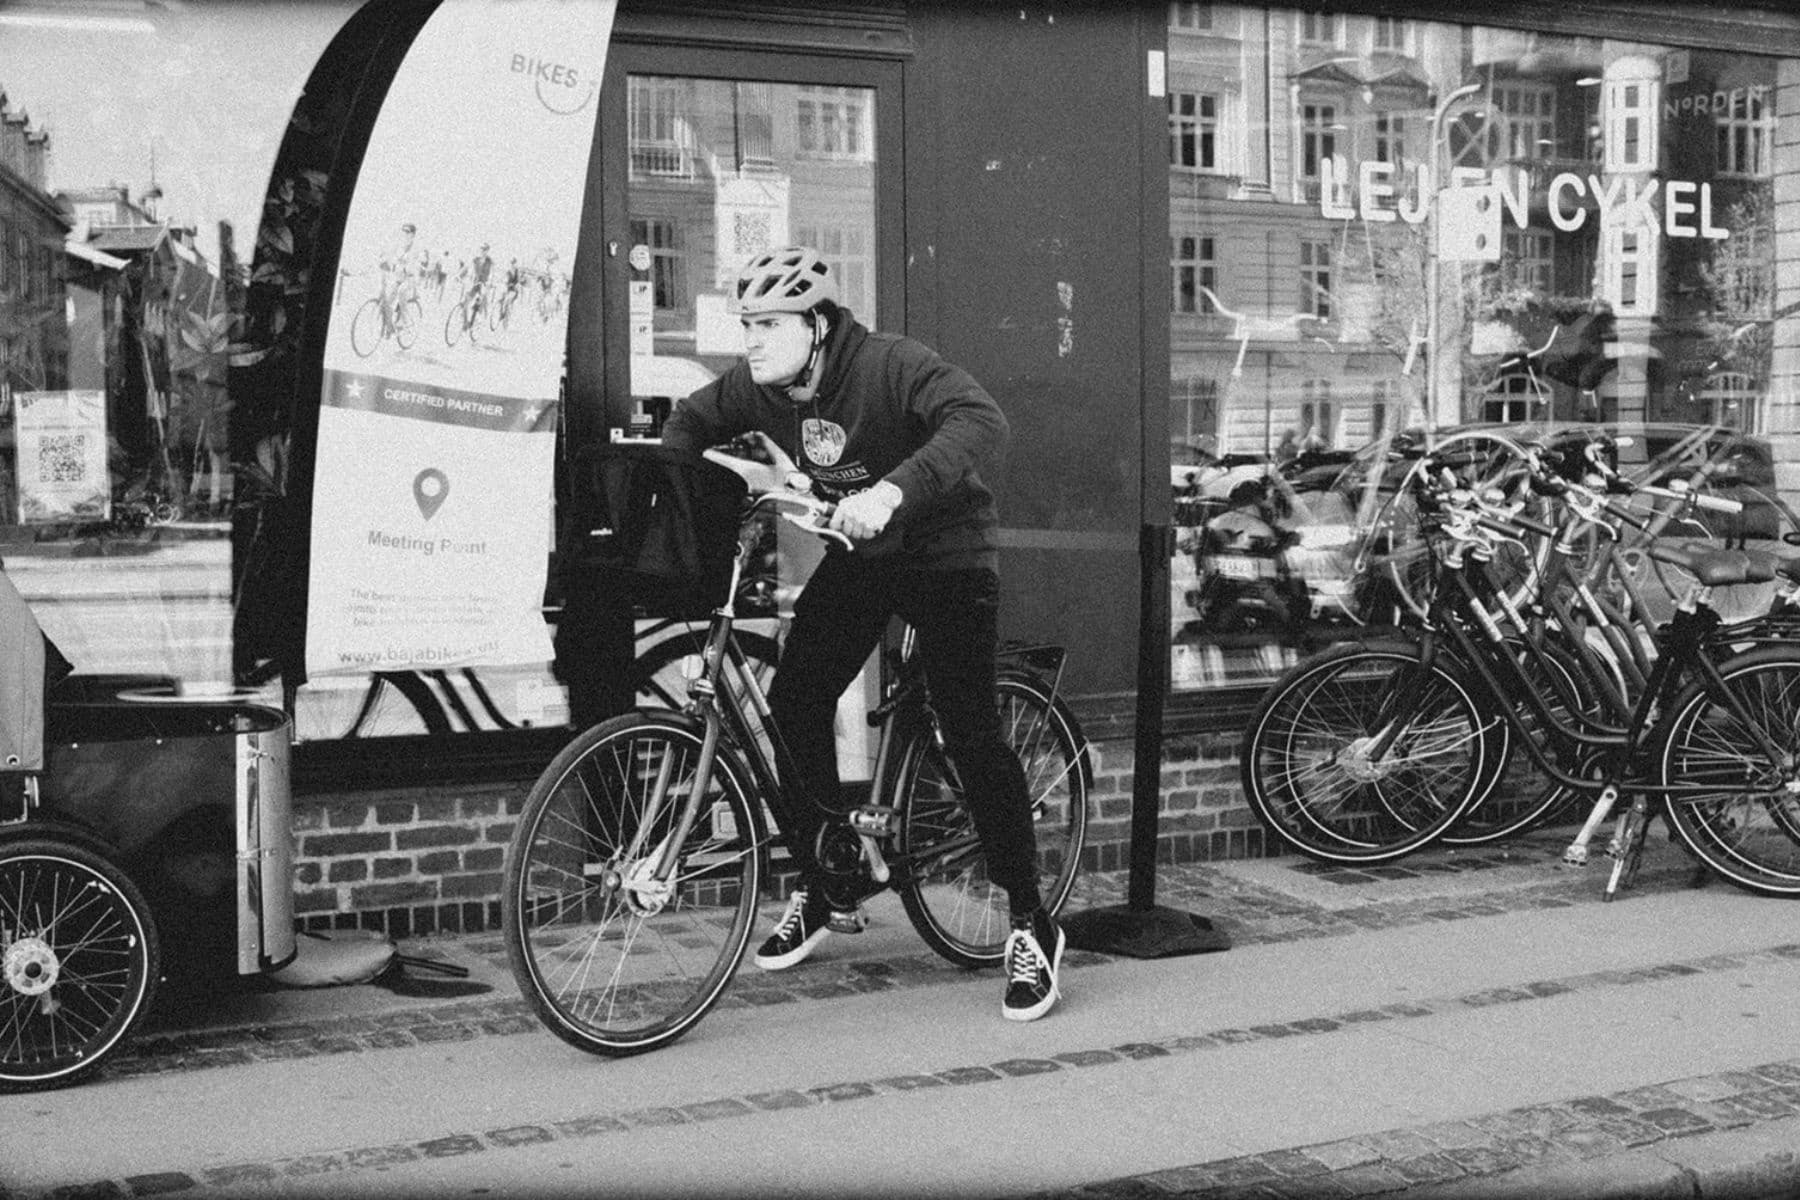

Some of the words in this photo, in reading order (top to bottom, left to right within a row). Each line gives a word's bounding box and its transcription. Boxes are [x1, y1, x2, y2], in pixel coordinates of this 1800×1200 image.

[511, 53, 579, 89] BIKES
[1320, 156, 1430, 223] LEJ
[1548, 172, 1730, 239] CYKEL
[384, 388, 445, 408] CERTIFIED
[447, 398, 504, 417] PARTNER
[368, 530, 435, 556] Meeting
